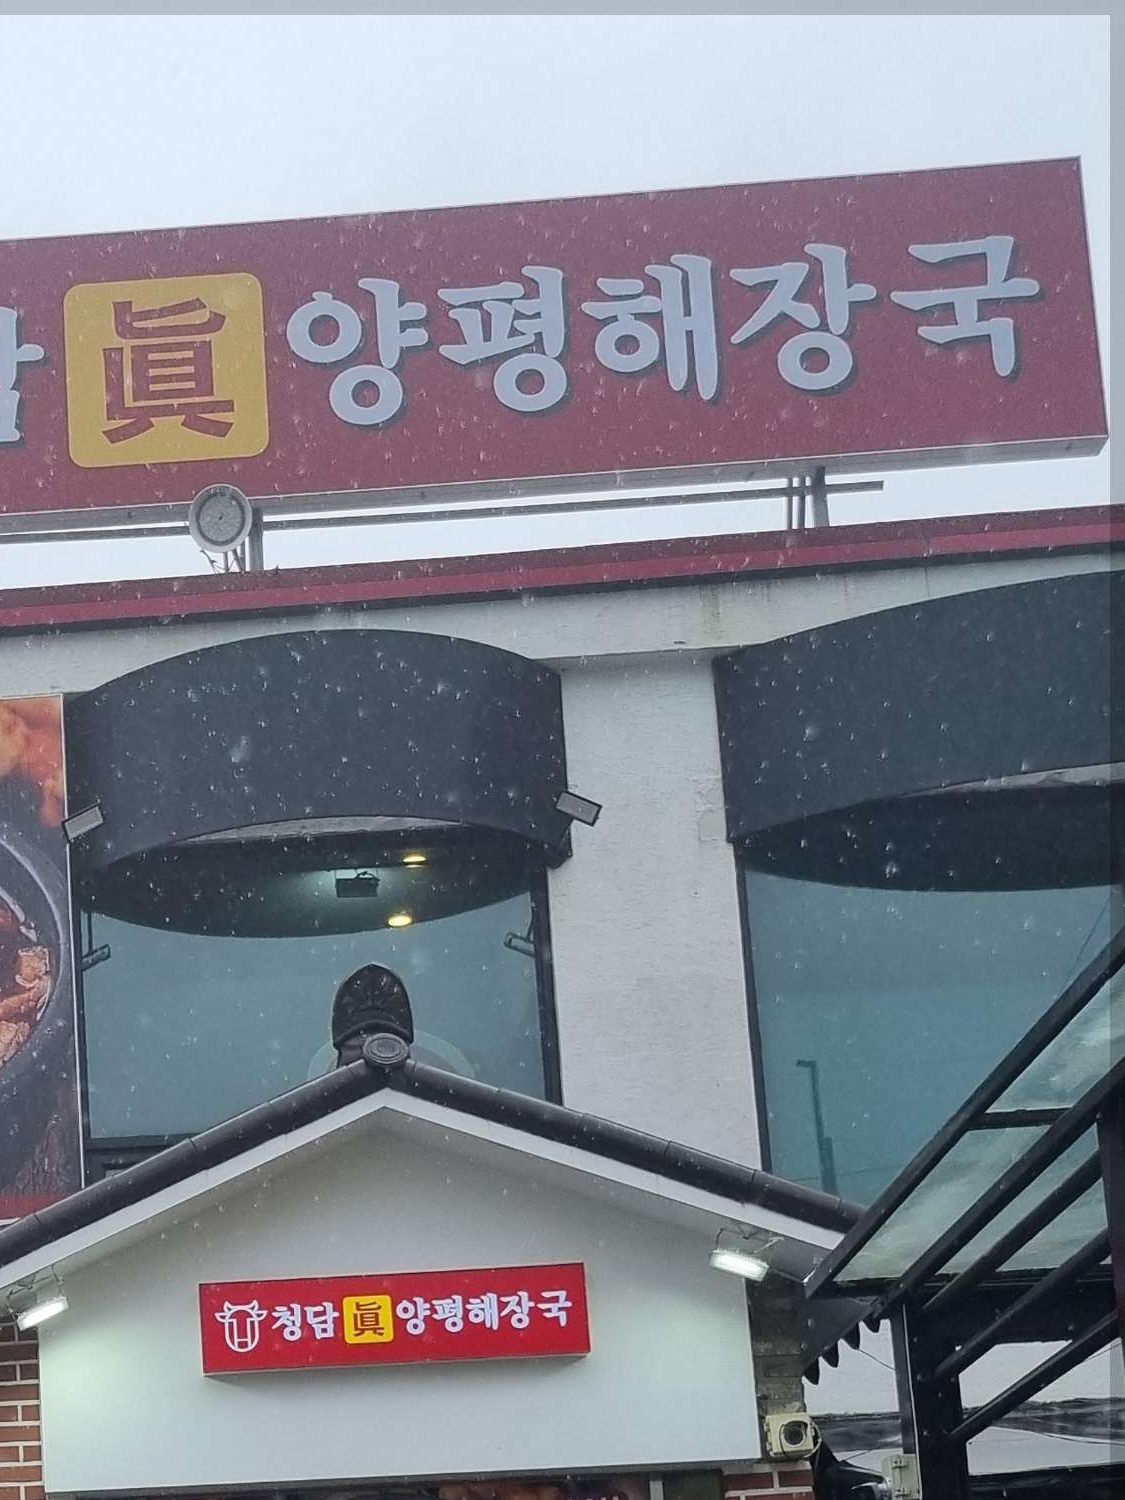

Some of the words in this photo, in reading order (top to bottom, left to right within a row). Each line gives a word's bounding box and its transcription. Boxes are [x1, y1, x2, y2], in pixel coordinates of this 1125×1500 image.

[100, 297, 236, 446] 眞
[285, 234, 1041, 427] 양평해장국
[271, 1301, 340, 1341] 청담
[351, 1300, 385, 1338] 眞
[395, 1289, 574, 1336] 양평해장국
